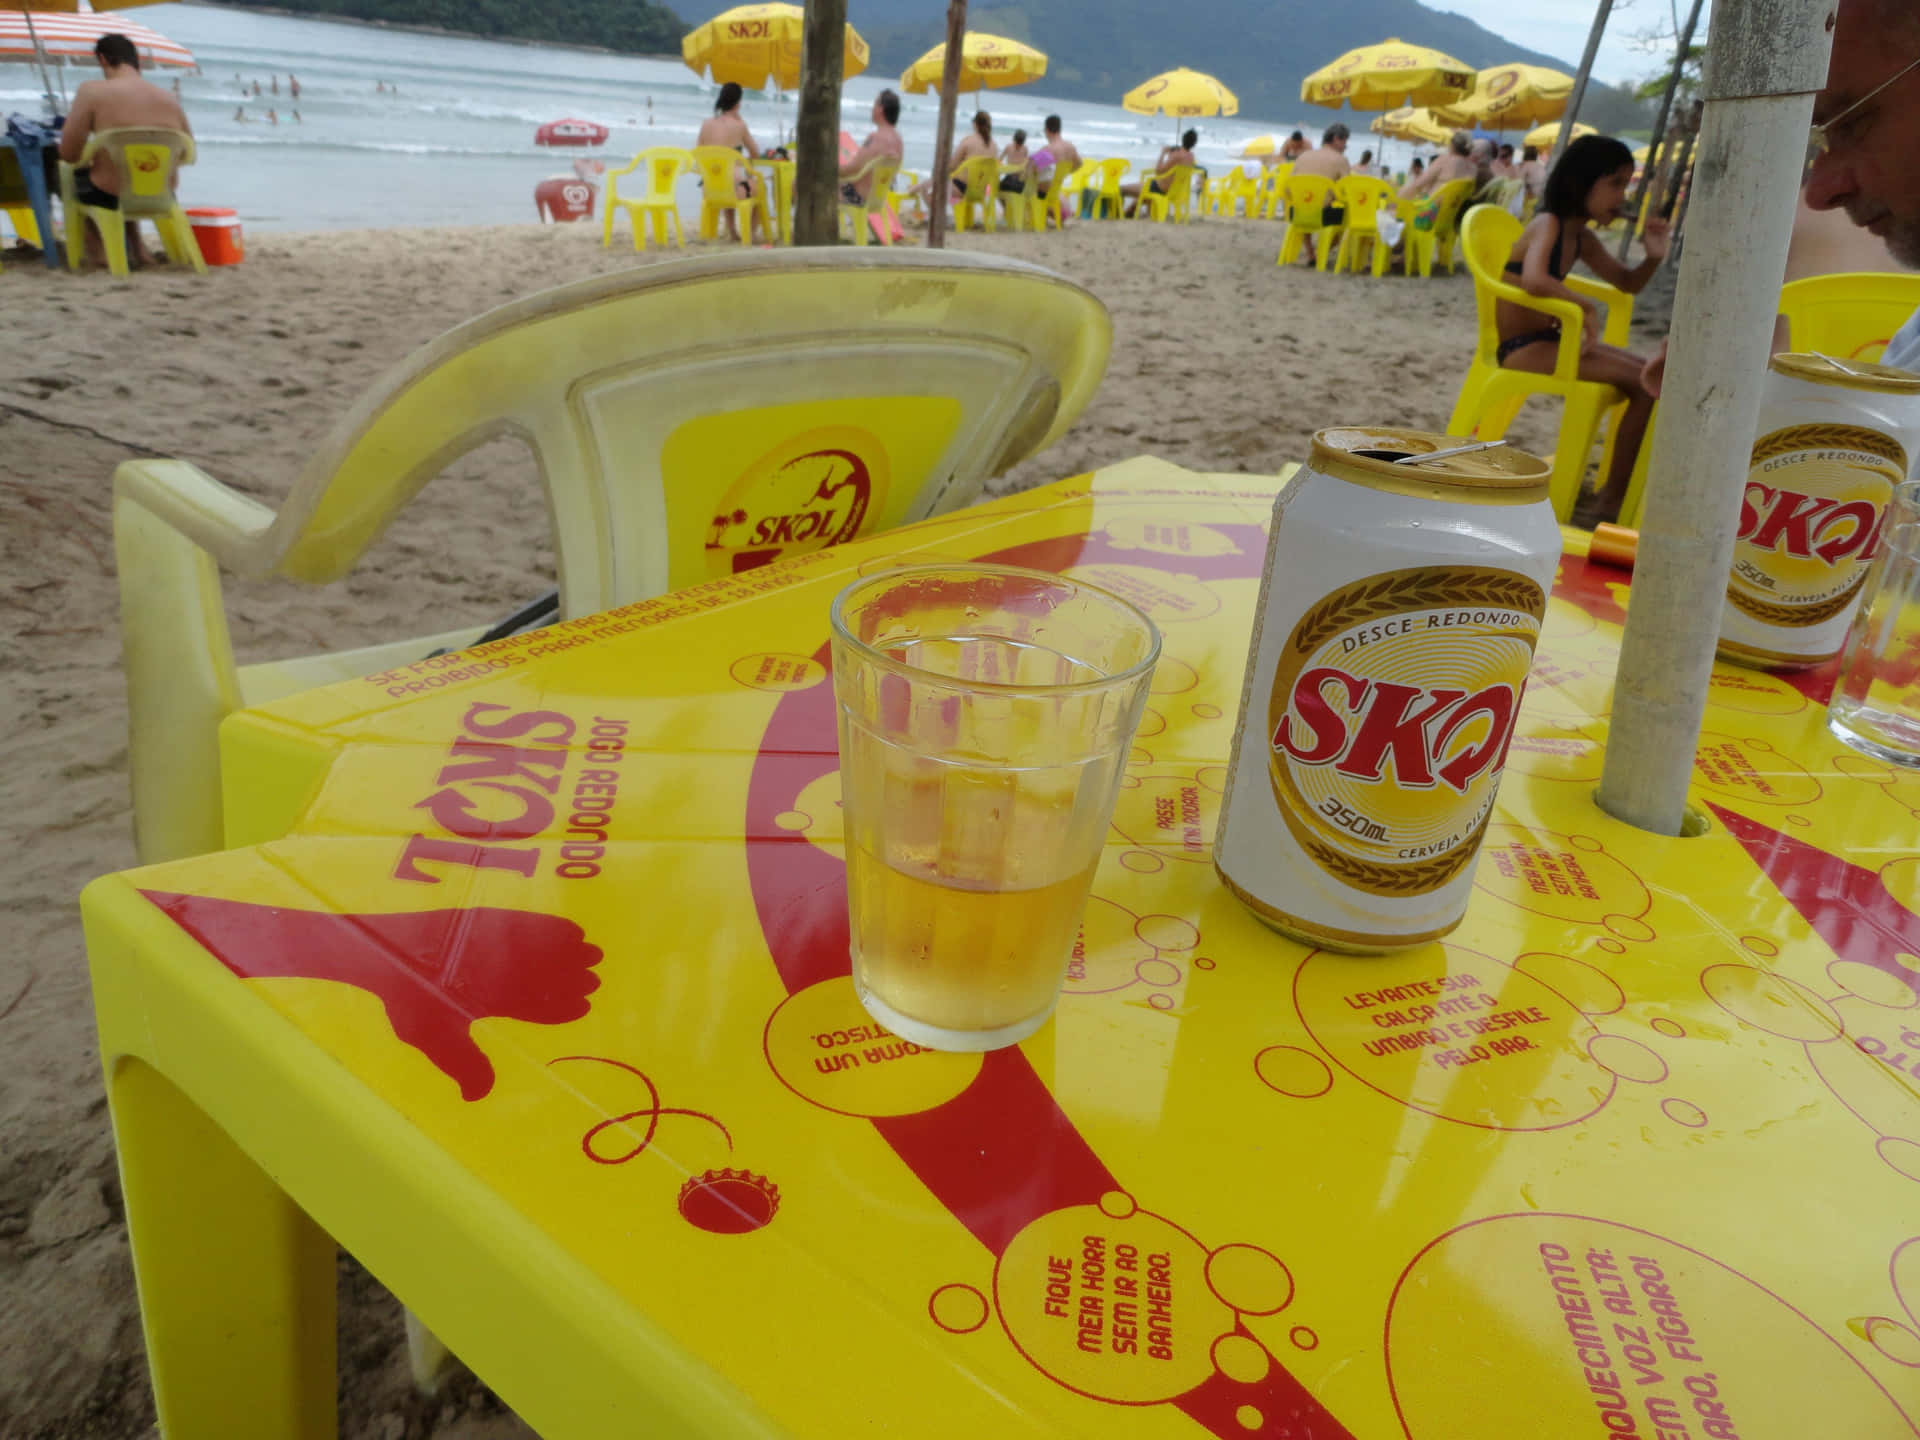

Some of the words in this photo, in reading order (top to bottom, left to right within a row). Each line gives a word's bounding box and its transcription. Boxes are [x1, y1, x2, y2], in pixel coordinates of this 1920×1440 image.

[1763, 452, 1809, 473] DESCE
[1816, 451, 1884, 467] REDONDO
[747, 509, 837, 547] SKOL
[386, 652, 528, 698] PROIBIDOS
[527, 633, 596, 659] PARA
[591, 604, 701, 640] MENORES
[1341, 617, 1412, 654] DESCE
[1427, 611, 1521, 629] REDONDO
[364, 669, 409, 687] SE
[407, 652, 462, 675] FOR
[583, 715, 631, 765] JOGO
[394, 701, 577, 884] SKOL
[555, 768, 620, 880] REDONDO
[1397, 833, 1461, 860] CERVEJA
[1343, 980, 1441, 1011] LEVANTE
[1436, 973, 1482, 994] SUA
[1371, 1004, 1439, 1028] CALÇA
[1436, 993, 1479, 1017] ATÉ
[1478, 992, 1499, 1007] O
[810, 1023, 895, 1049] TISCO.
[863, 1040, 936, 1064] OMA
[1361, 1026, 1450, 1057] UMBIGO
[1447, 1022, 1469, 1039] E
[1465, 1006, 1551, 1035] DESFILE
[1432, 1044, 1491, 1071] PELO
[1488, 1035, 1541, 1057] BAR.
[814, 1052, 861, 1074] UM
[1081, 1235, 1106, 1292] HORA
[1114, 1243, 1139, 1273] AO
[1044, 1254, 1073, 1319] FIQUE
[1113, 1274, 1139, 1299] IR
[1147, 1251, 1173, 1361] BANHEIRO.
[1077, 1294, 1106, 1353] MEIA
[1112, 1301, 1139, 1356] SEM
[1628, 1254, 1704, 1363] FÍGARO!
[1612, 1323, 1665, 1386] VOZ
